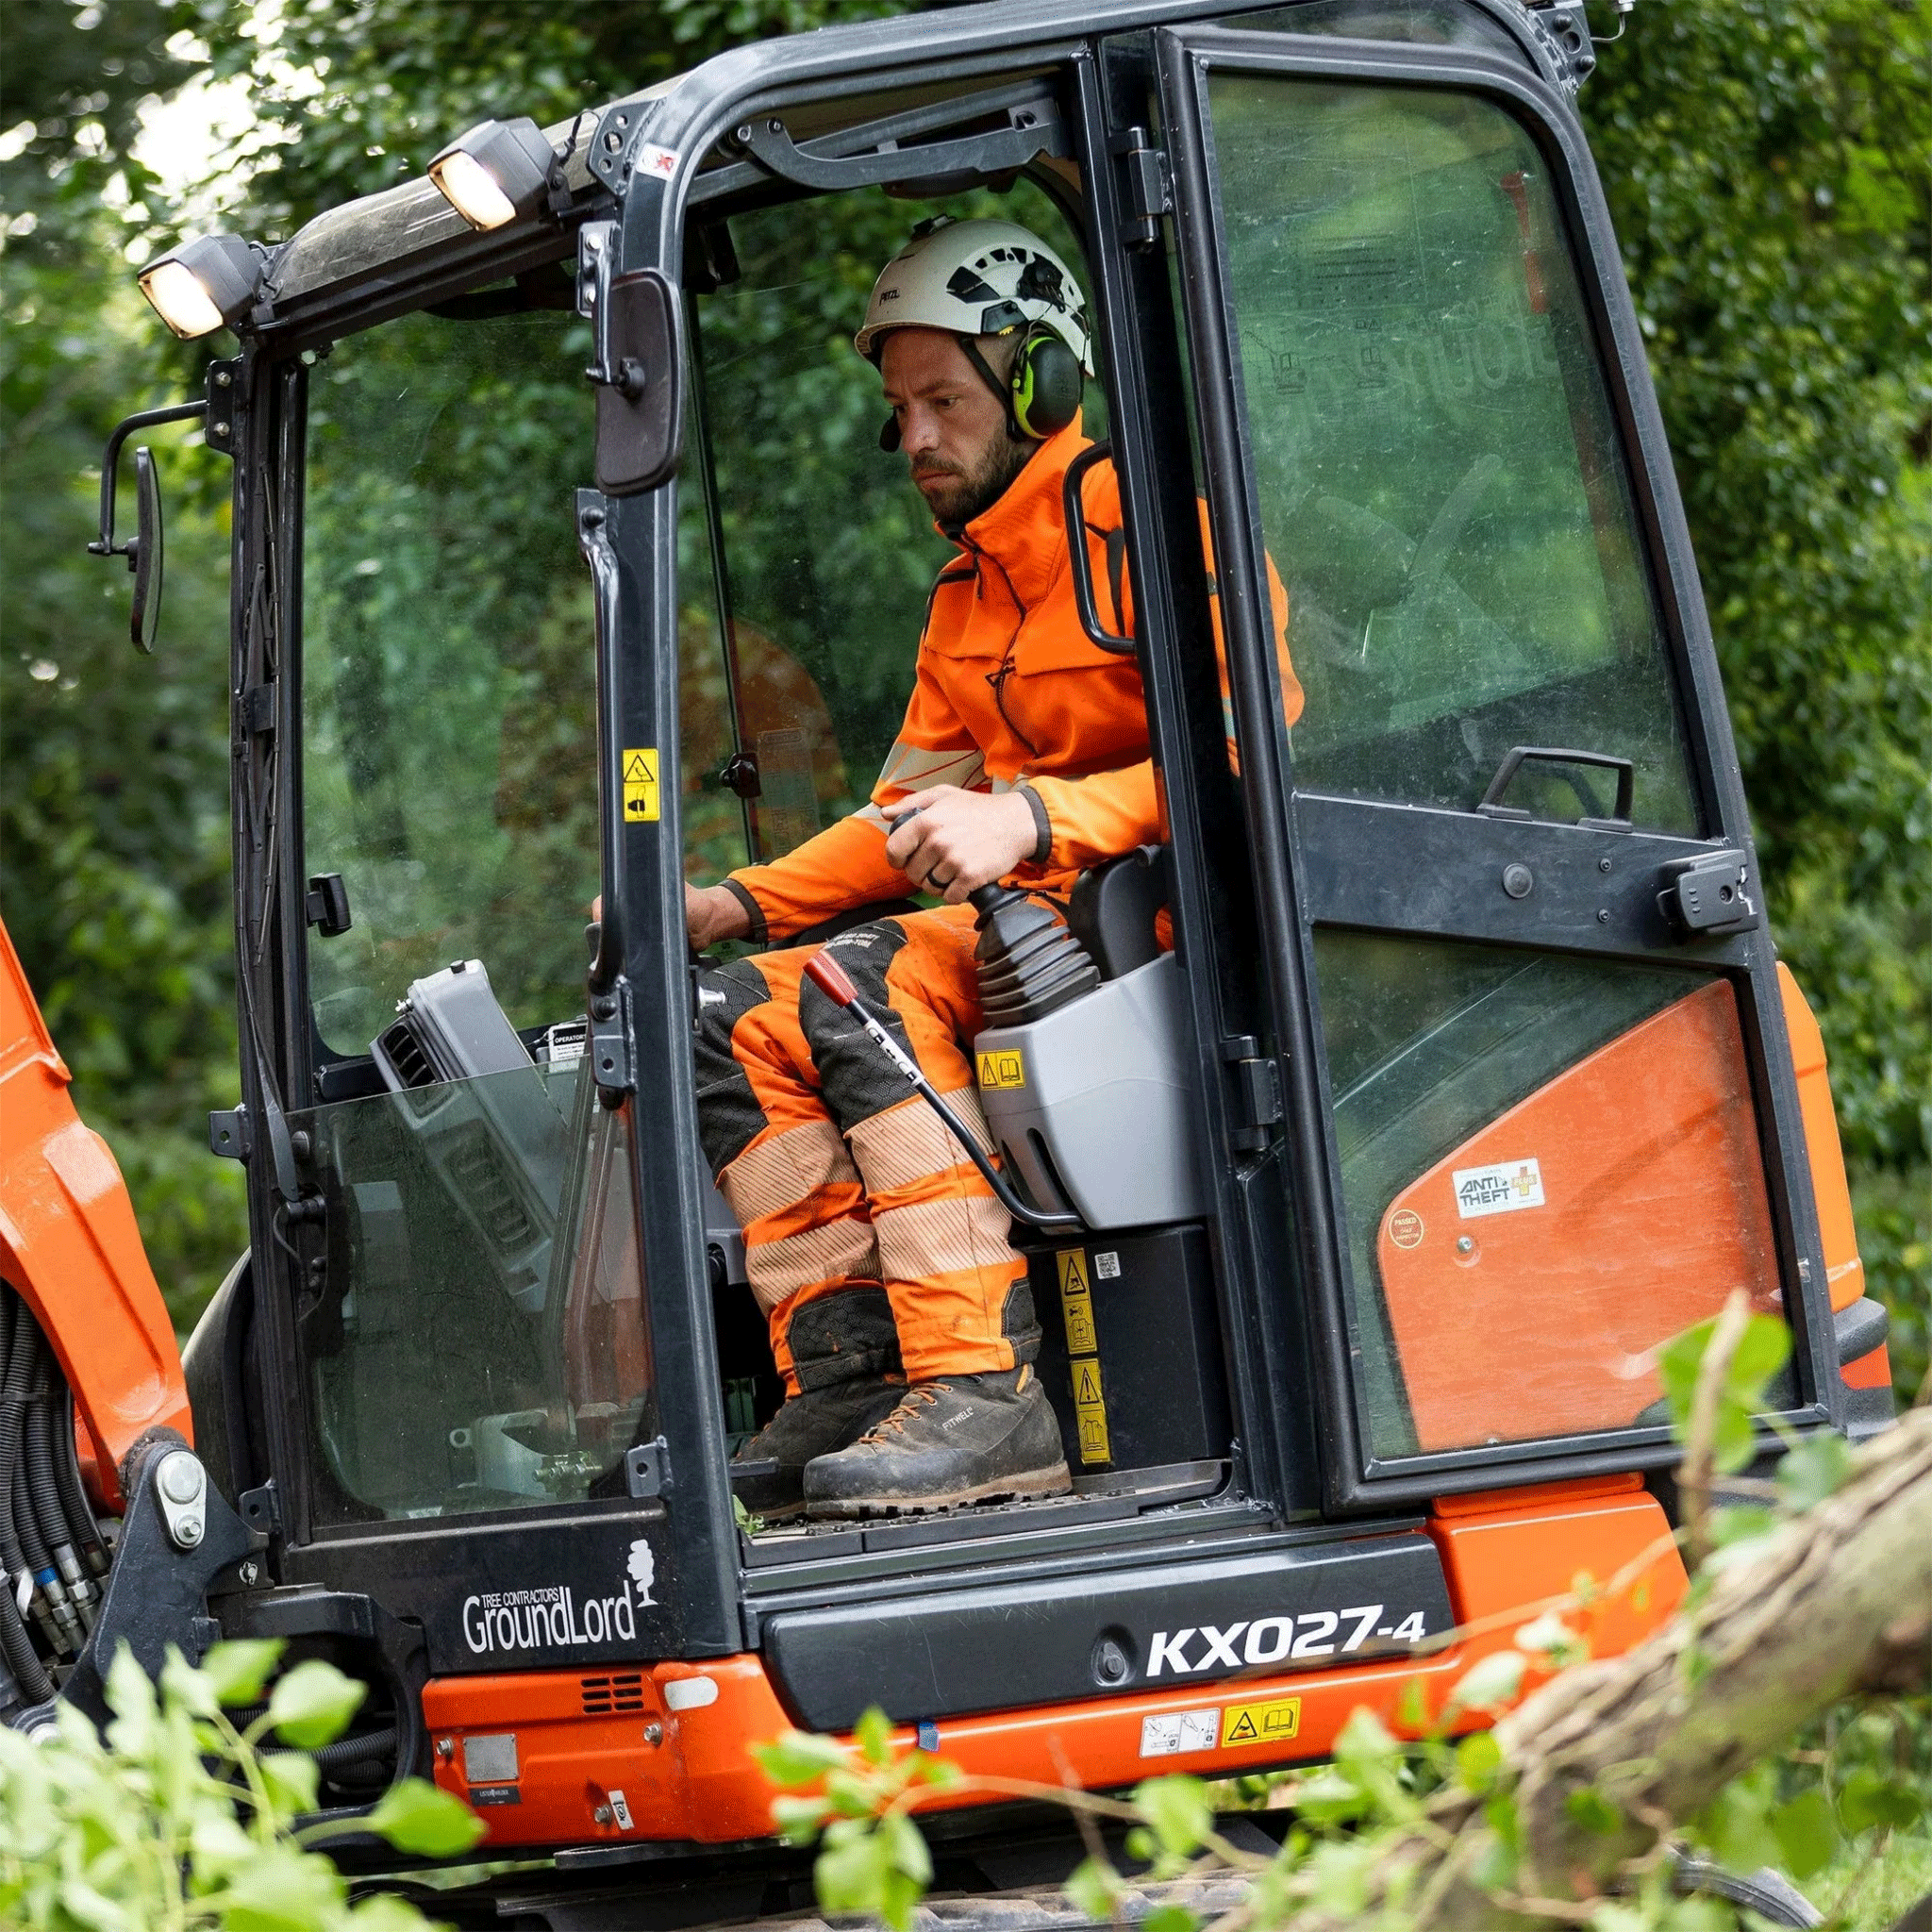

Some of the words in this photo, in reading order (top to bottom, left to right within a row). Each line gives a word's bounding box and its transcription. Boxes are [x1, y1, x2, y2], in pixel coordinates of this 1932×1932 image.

[1459, 1176, 1499, 1194] ANTI
[1459, 1188, 1510, 1208] THEFT
[481, 1593, 502, 1608] TREE
[503, 1588, 559, 1606] CONTRACTORS
[462, 1579, 637, 1654] GroundLord
[1146, 1604, 1425, 1677] KX027-4
